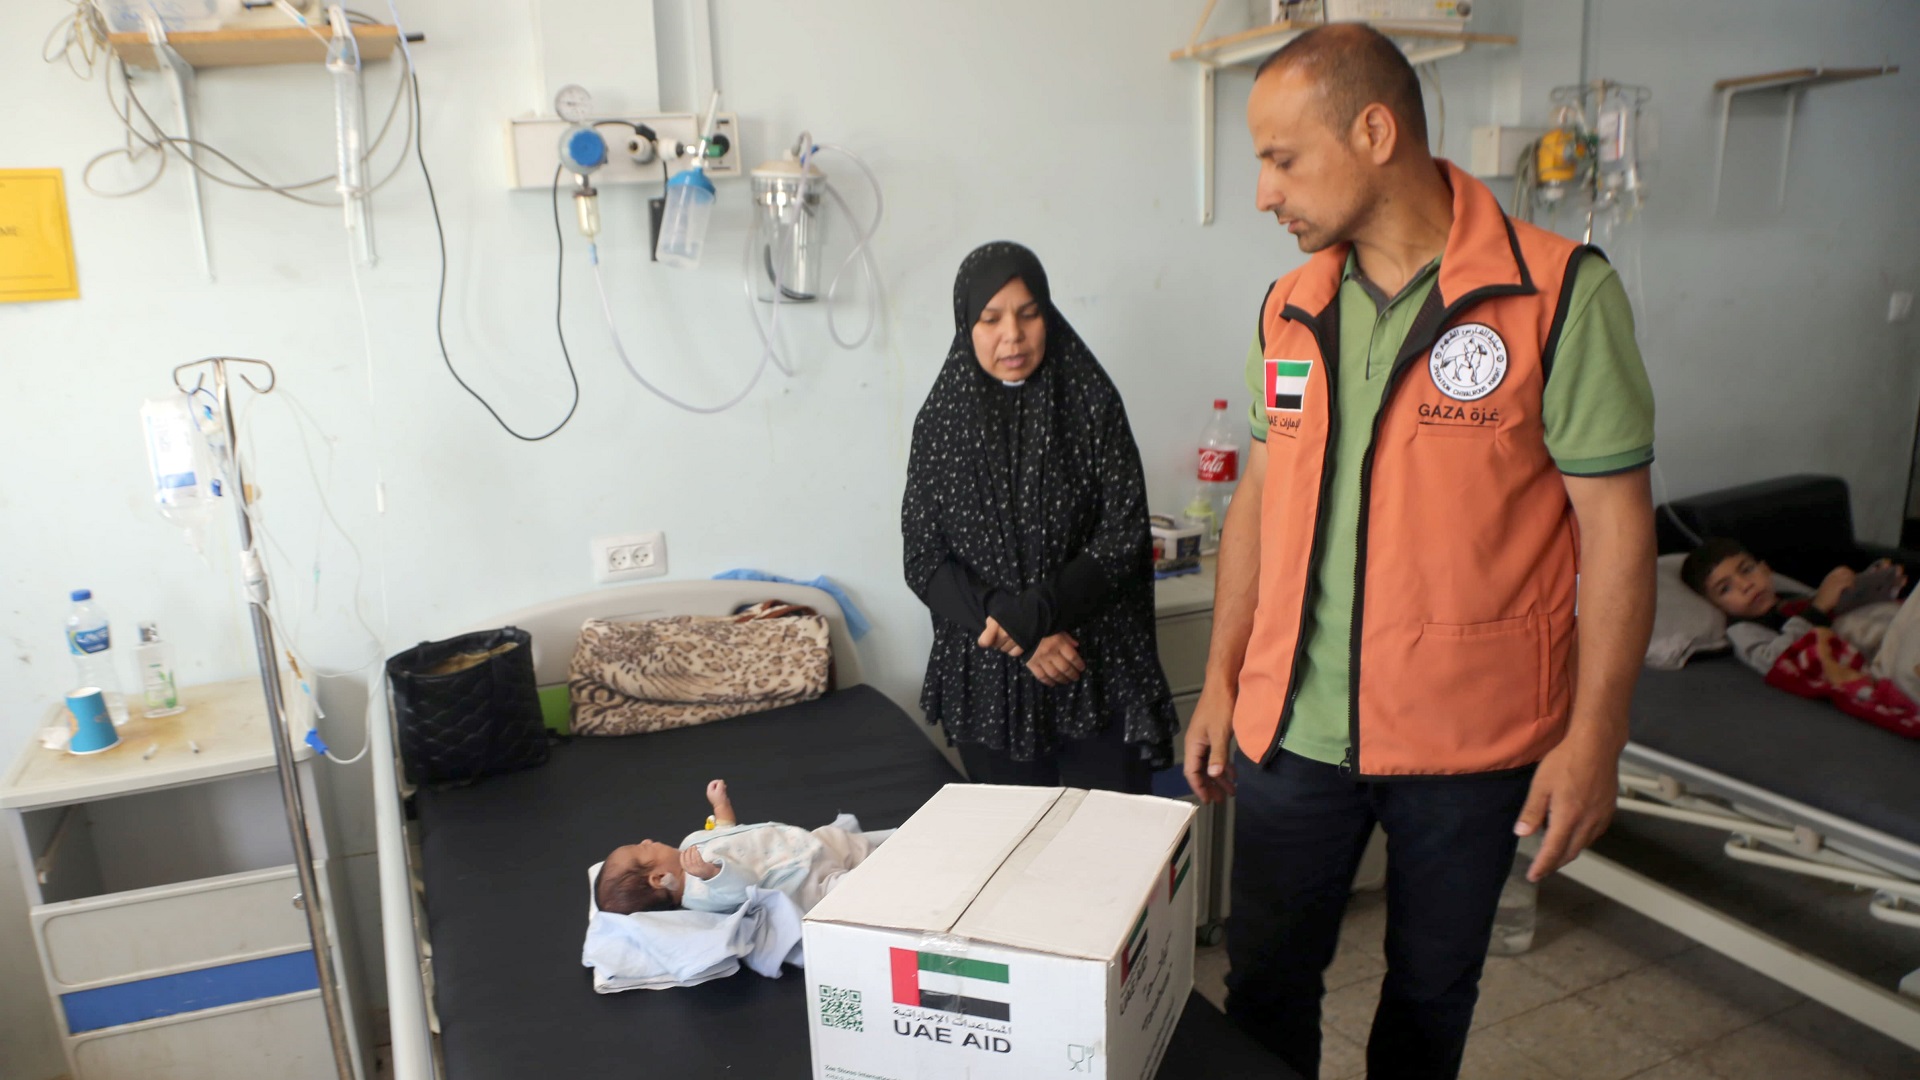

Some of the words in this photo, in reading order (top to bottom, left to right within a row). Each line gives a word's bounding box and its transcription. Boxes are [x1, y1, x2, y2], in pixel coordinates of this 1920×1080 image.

[1433, 363, 1452, 392] OPERATION
[1452, 385, 1488, 397] CHIVALROUS
[1487, 367, 1502, 387] KNIGHT
[1418, 403, 1466, 420] GAZA
[1470, 407, 1499, 425] غزة
[1200, 450, 1226, 473] Cola
[893, 1019, 952, 1045] UAE
[961, 1032, 1012, 1055] AID
